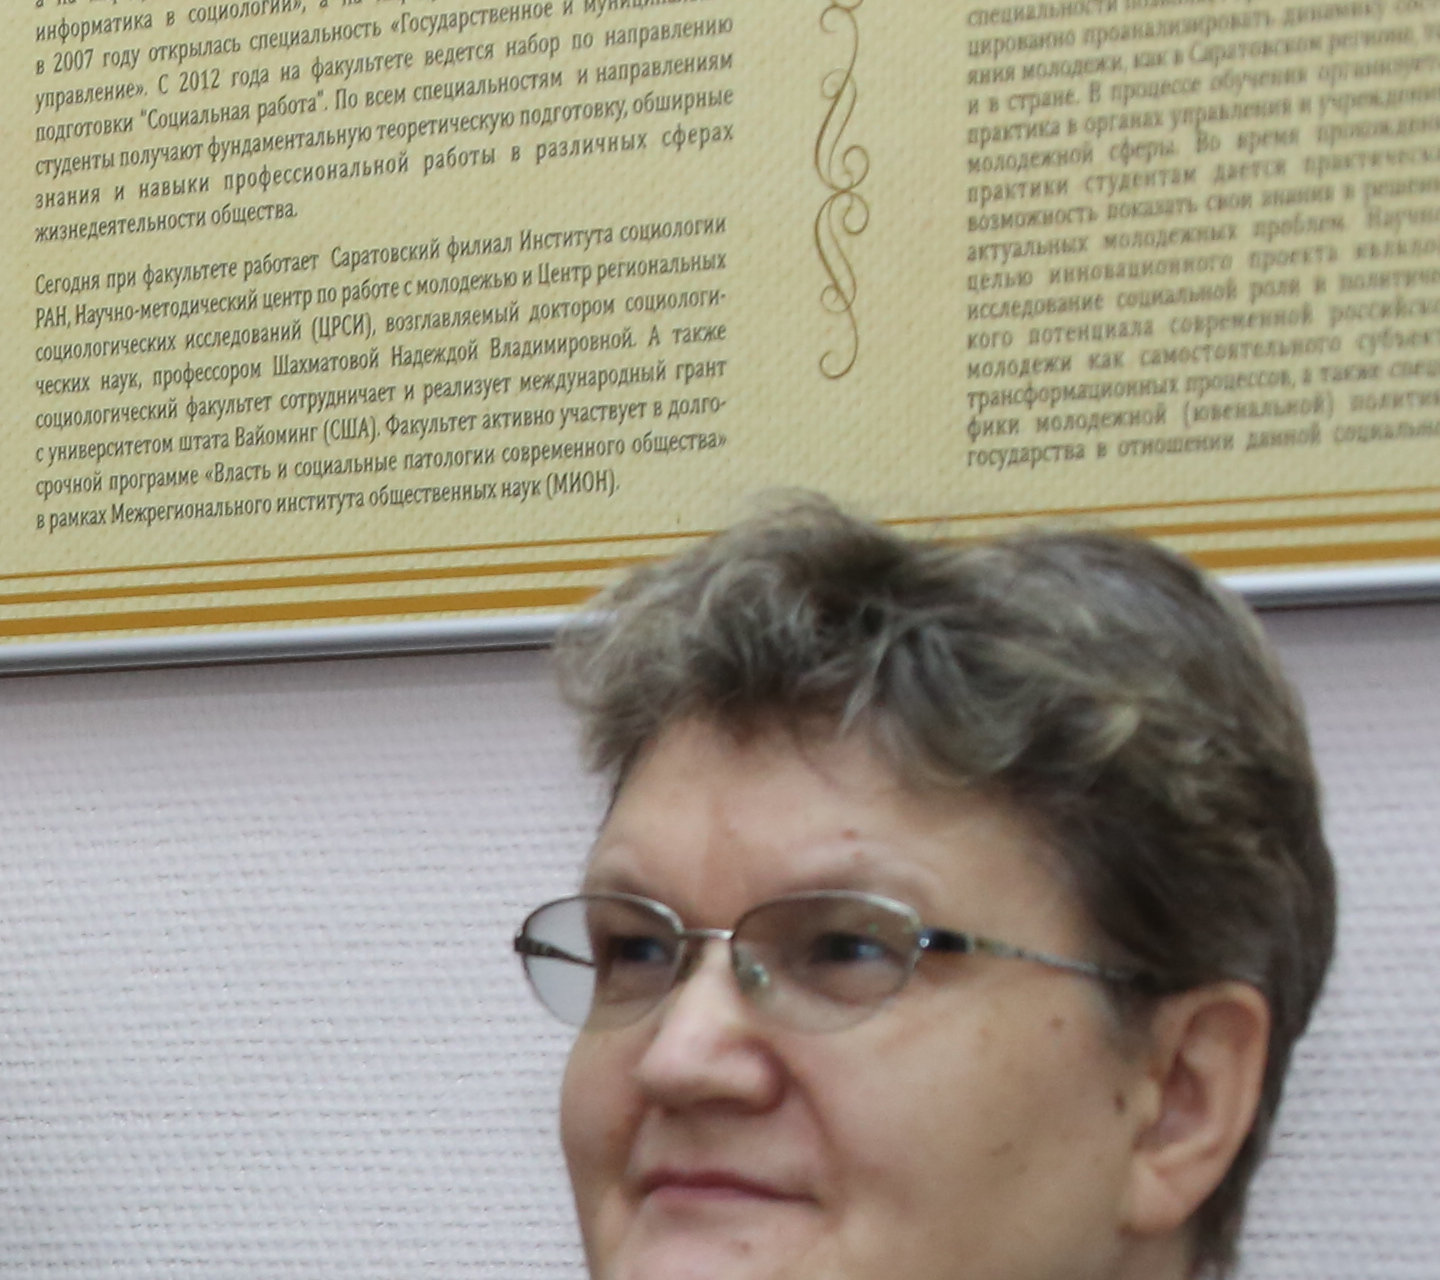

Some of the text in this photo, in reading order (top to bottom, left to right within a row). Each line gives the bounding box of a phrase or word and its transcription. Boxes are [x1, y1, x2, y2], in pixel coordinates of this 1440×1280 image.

[35, 0, 307, 46] информатика в социологии»,
[35, 58, 45, 76] в
[52, 47, 94, 74] 2007
[101, 47, 141, 72] году
[147, 36, 241, 67] открылась
[248, 20, 382, 52] специальность
[389, 1, 553, 38] «Государственное
[561, 0, 574, 16] и
[34, 16, 734, 116] управление». С 2012 года на факультете ведется набор по направлению
[34, 52, 734, 145] подготовки "Социальная работа". По всем специальностям и направлениям
[34, 88, 734, 181] студенты получают фундаментальную теоретическую подготовку, обширные
[34, 121, 734, 210] знания и навыки профессиональной работы в различных сферах
[34, 201, 298, 243] жизнедеятельности общества.
[34, 216, 727, 298] Сегодня при факультете работает Саратовский филиал Института социологии
[34, 252, 727, 331] РАН, Научно-методический центр по работе с молодежью и Центр региональных
[964, 268, 1034, 296] целью
[965, 291, 1105, 323] исследование
[34, 288, 727, 364] социологических исследований (ЦРСИ), возглавляемый доктором социологи-
[34, 323, 727, 397] ческих наук, профессором Шахматовой Надеждой Владимировной. А также
[965, 317, 1155, 352] кого потенциала
[34, 358, 728, 432] социологический факультет сотрудничает и реализует международный грант
[965, 353, 1073, 381] молодежи
[34, 396, 727, 469] с университетом штата Вайоминг (США). Факультет активно участвует в долго-
[964, 400, 1168, 445] фики молодежной
[965, 441, 1086, 473] государства
[1116, 431, 1235, 459] отношении
[35, 429, 728, 503] срочной программе «Власть и социальные патологии современного общества»
[35, 467, 620, 535] в рамках Межрегионального института общественных наук (МИОН).
